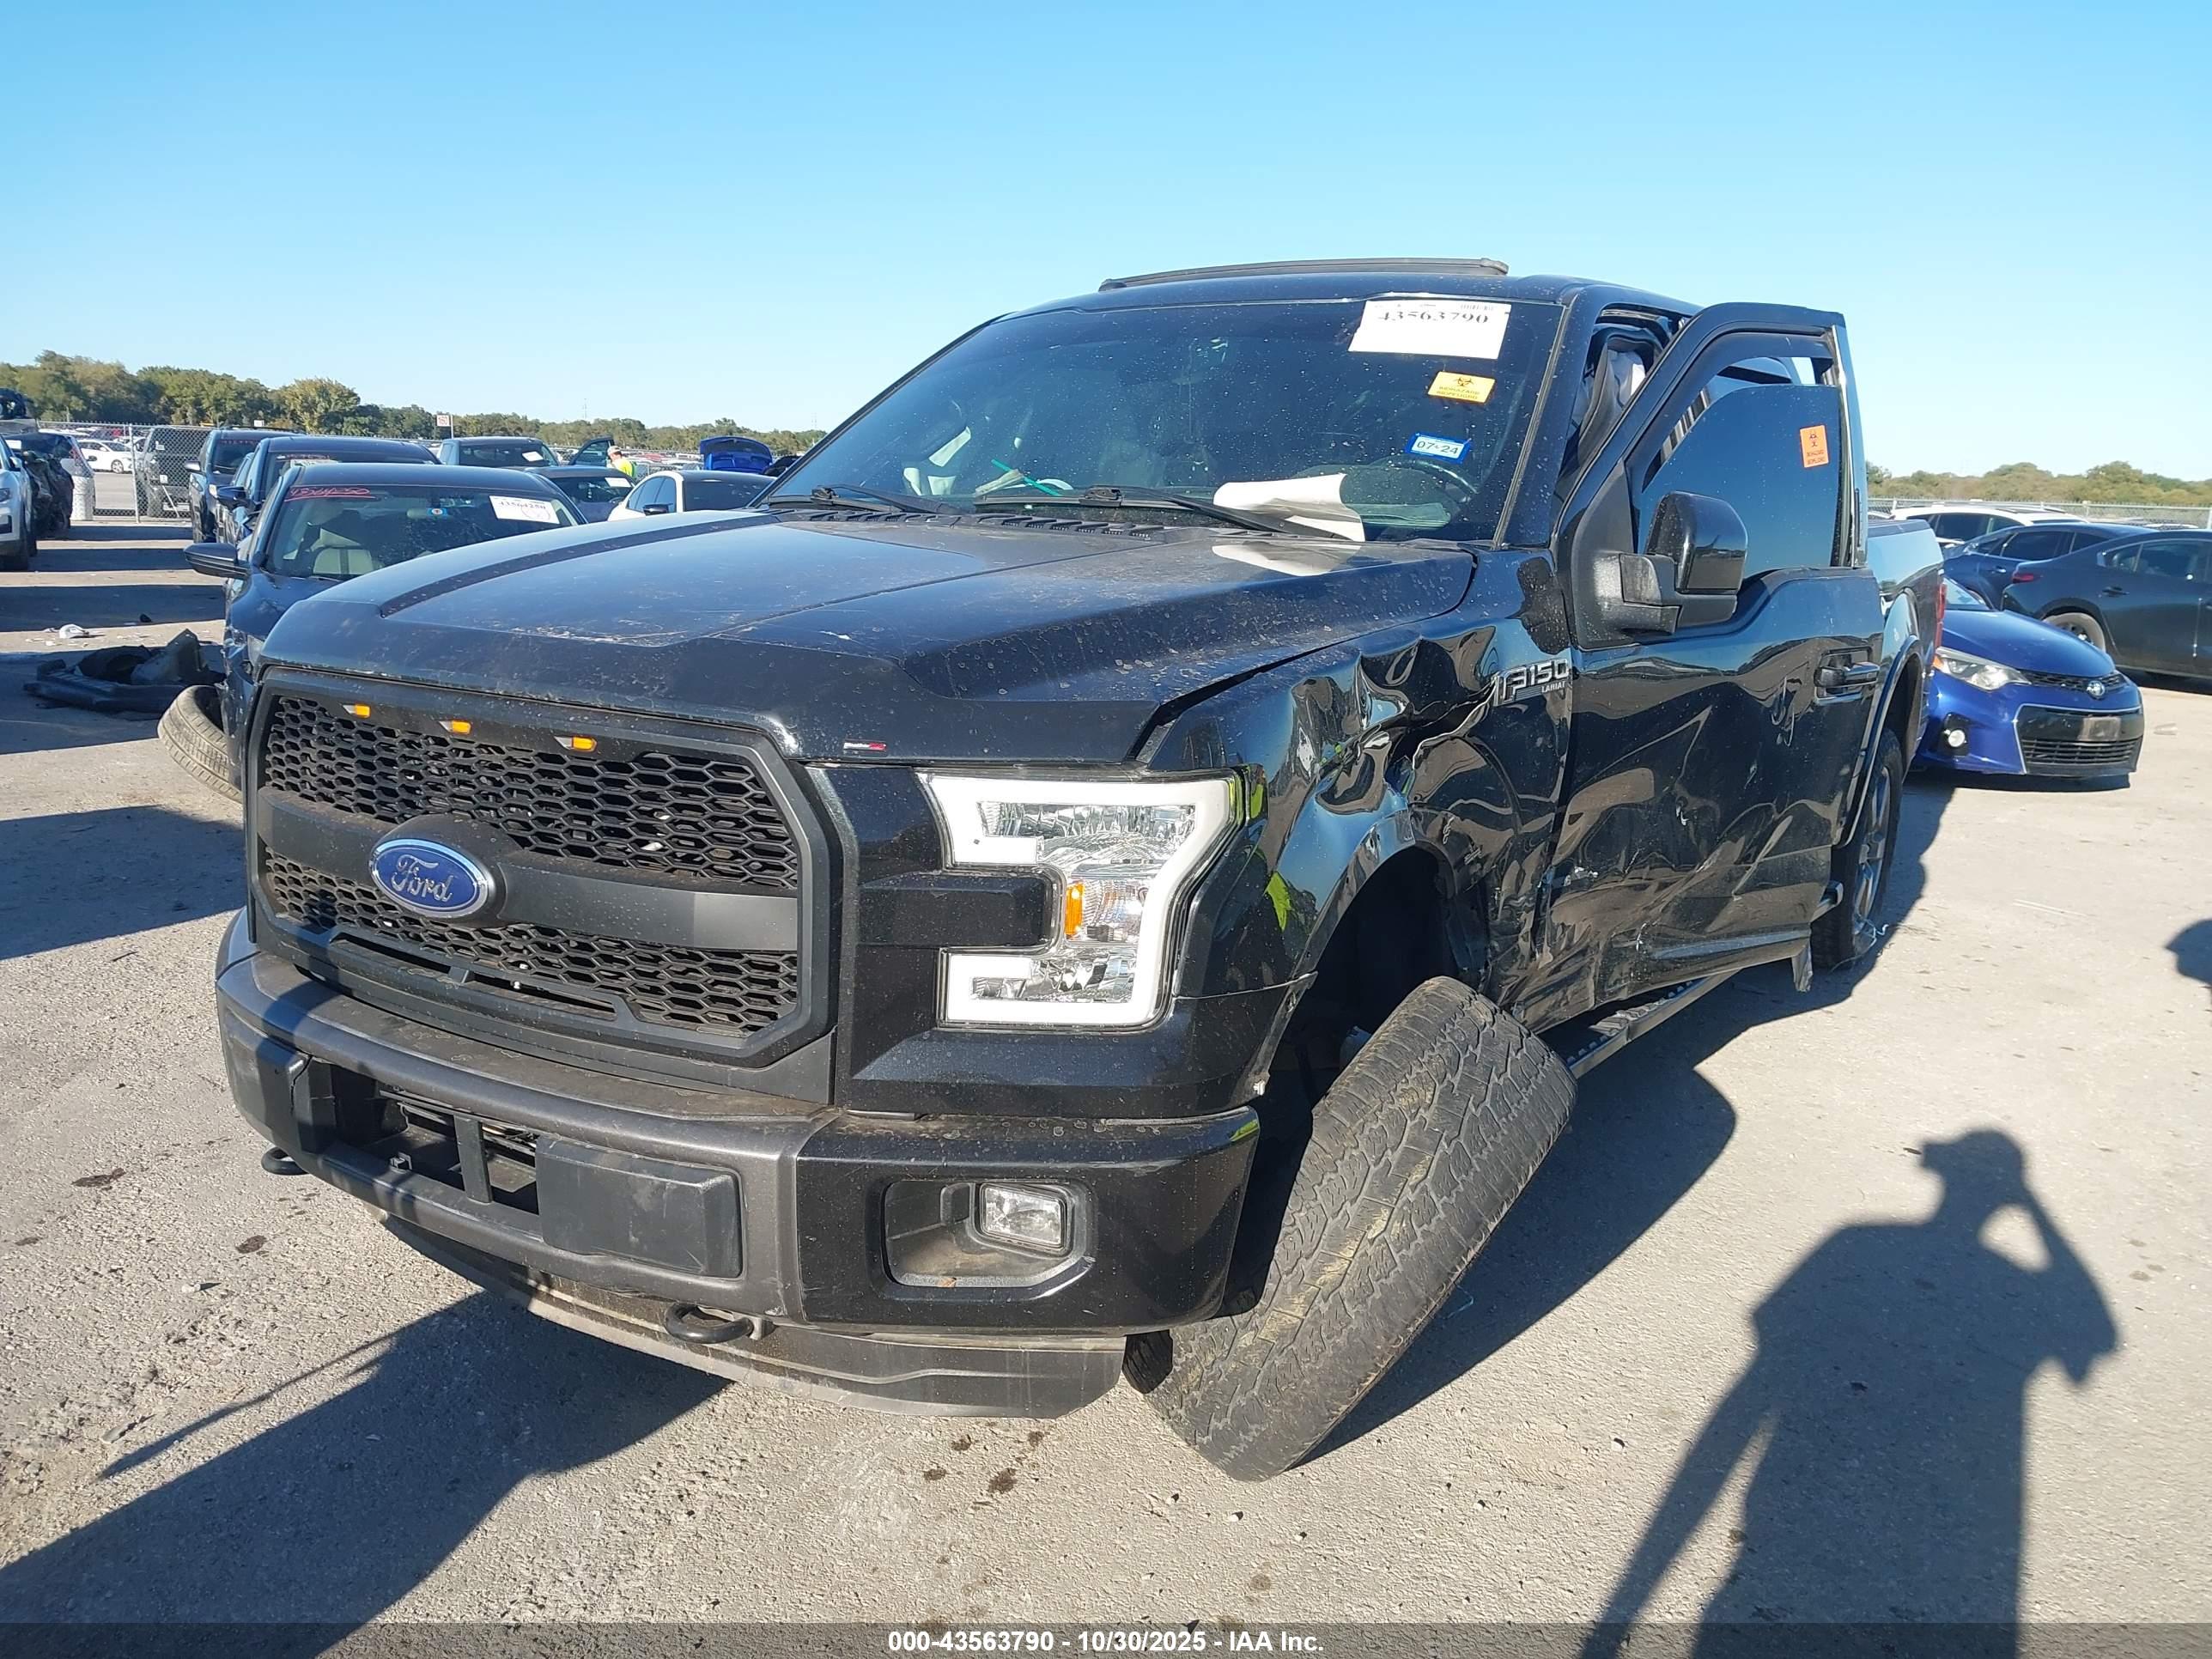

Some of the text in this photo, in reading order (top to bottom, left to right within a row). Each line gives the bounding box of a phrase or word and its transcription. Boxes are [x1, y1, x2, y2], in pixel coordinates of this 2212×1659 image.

[1377, 310, 1489, 324] 43563790
[1541, 681, 1566, 693] LARIAT
[391, 854, 454, 902] Ford
